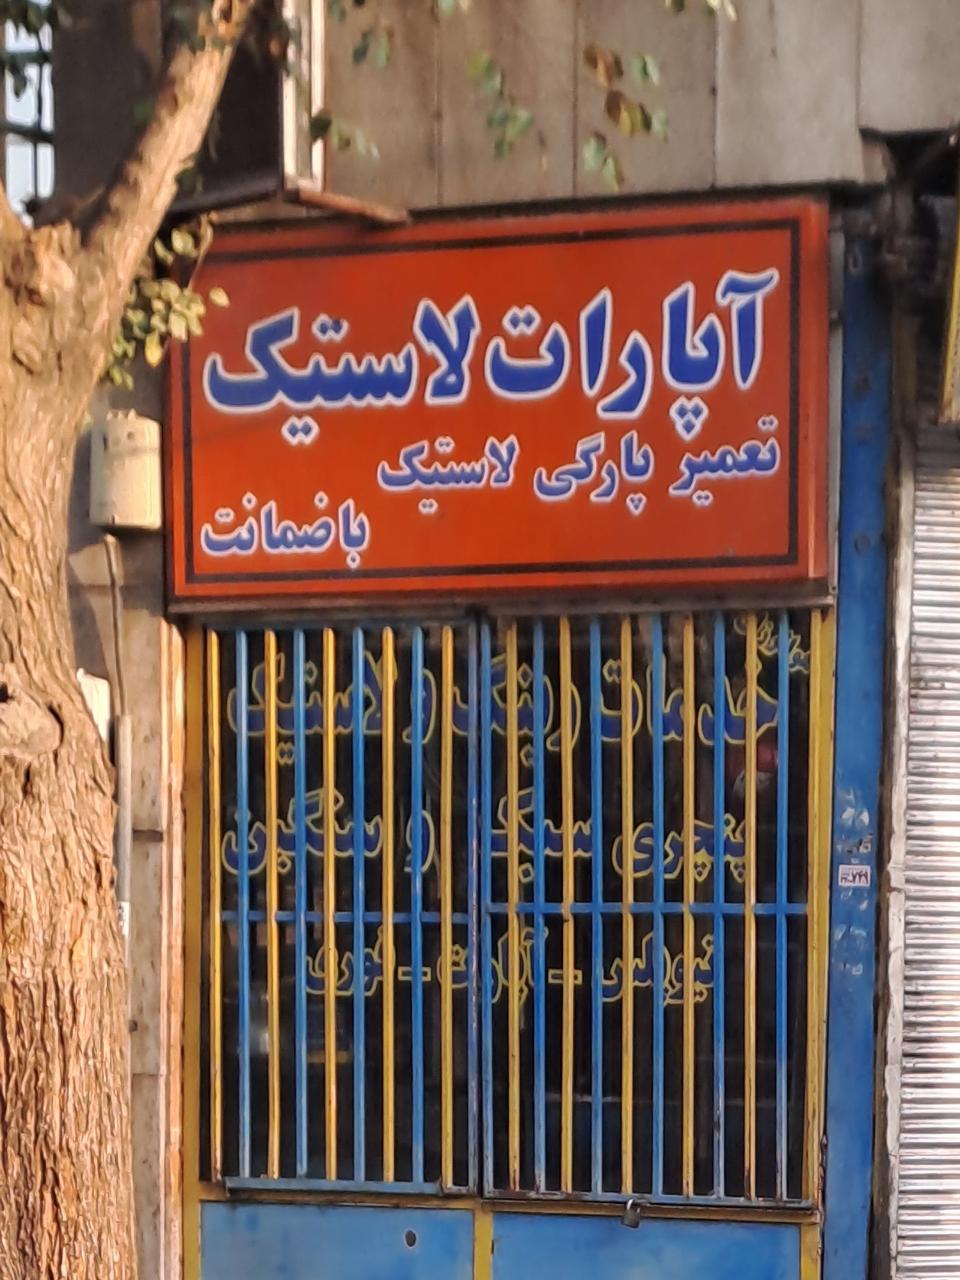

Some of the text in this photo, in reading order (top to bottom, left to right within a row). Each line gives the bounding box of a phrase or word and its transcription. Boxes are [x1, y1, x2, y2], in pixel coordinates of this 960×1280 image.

[203, 266, 779, 446] آپارات لاستیک
[377, 415, 781, 515] تعمیر پارگی لاستیک
[227, 650, 399, 765] لاستیک
